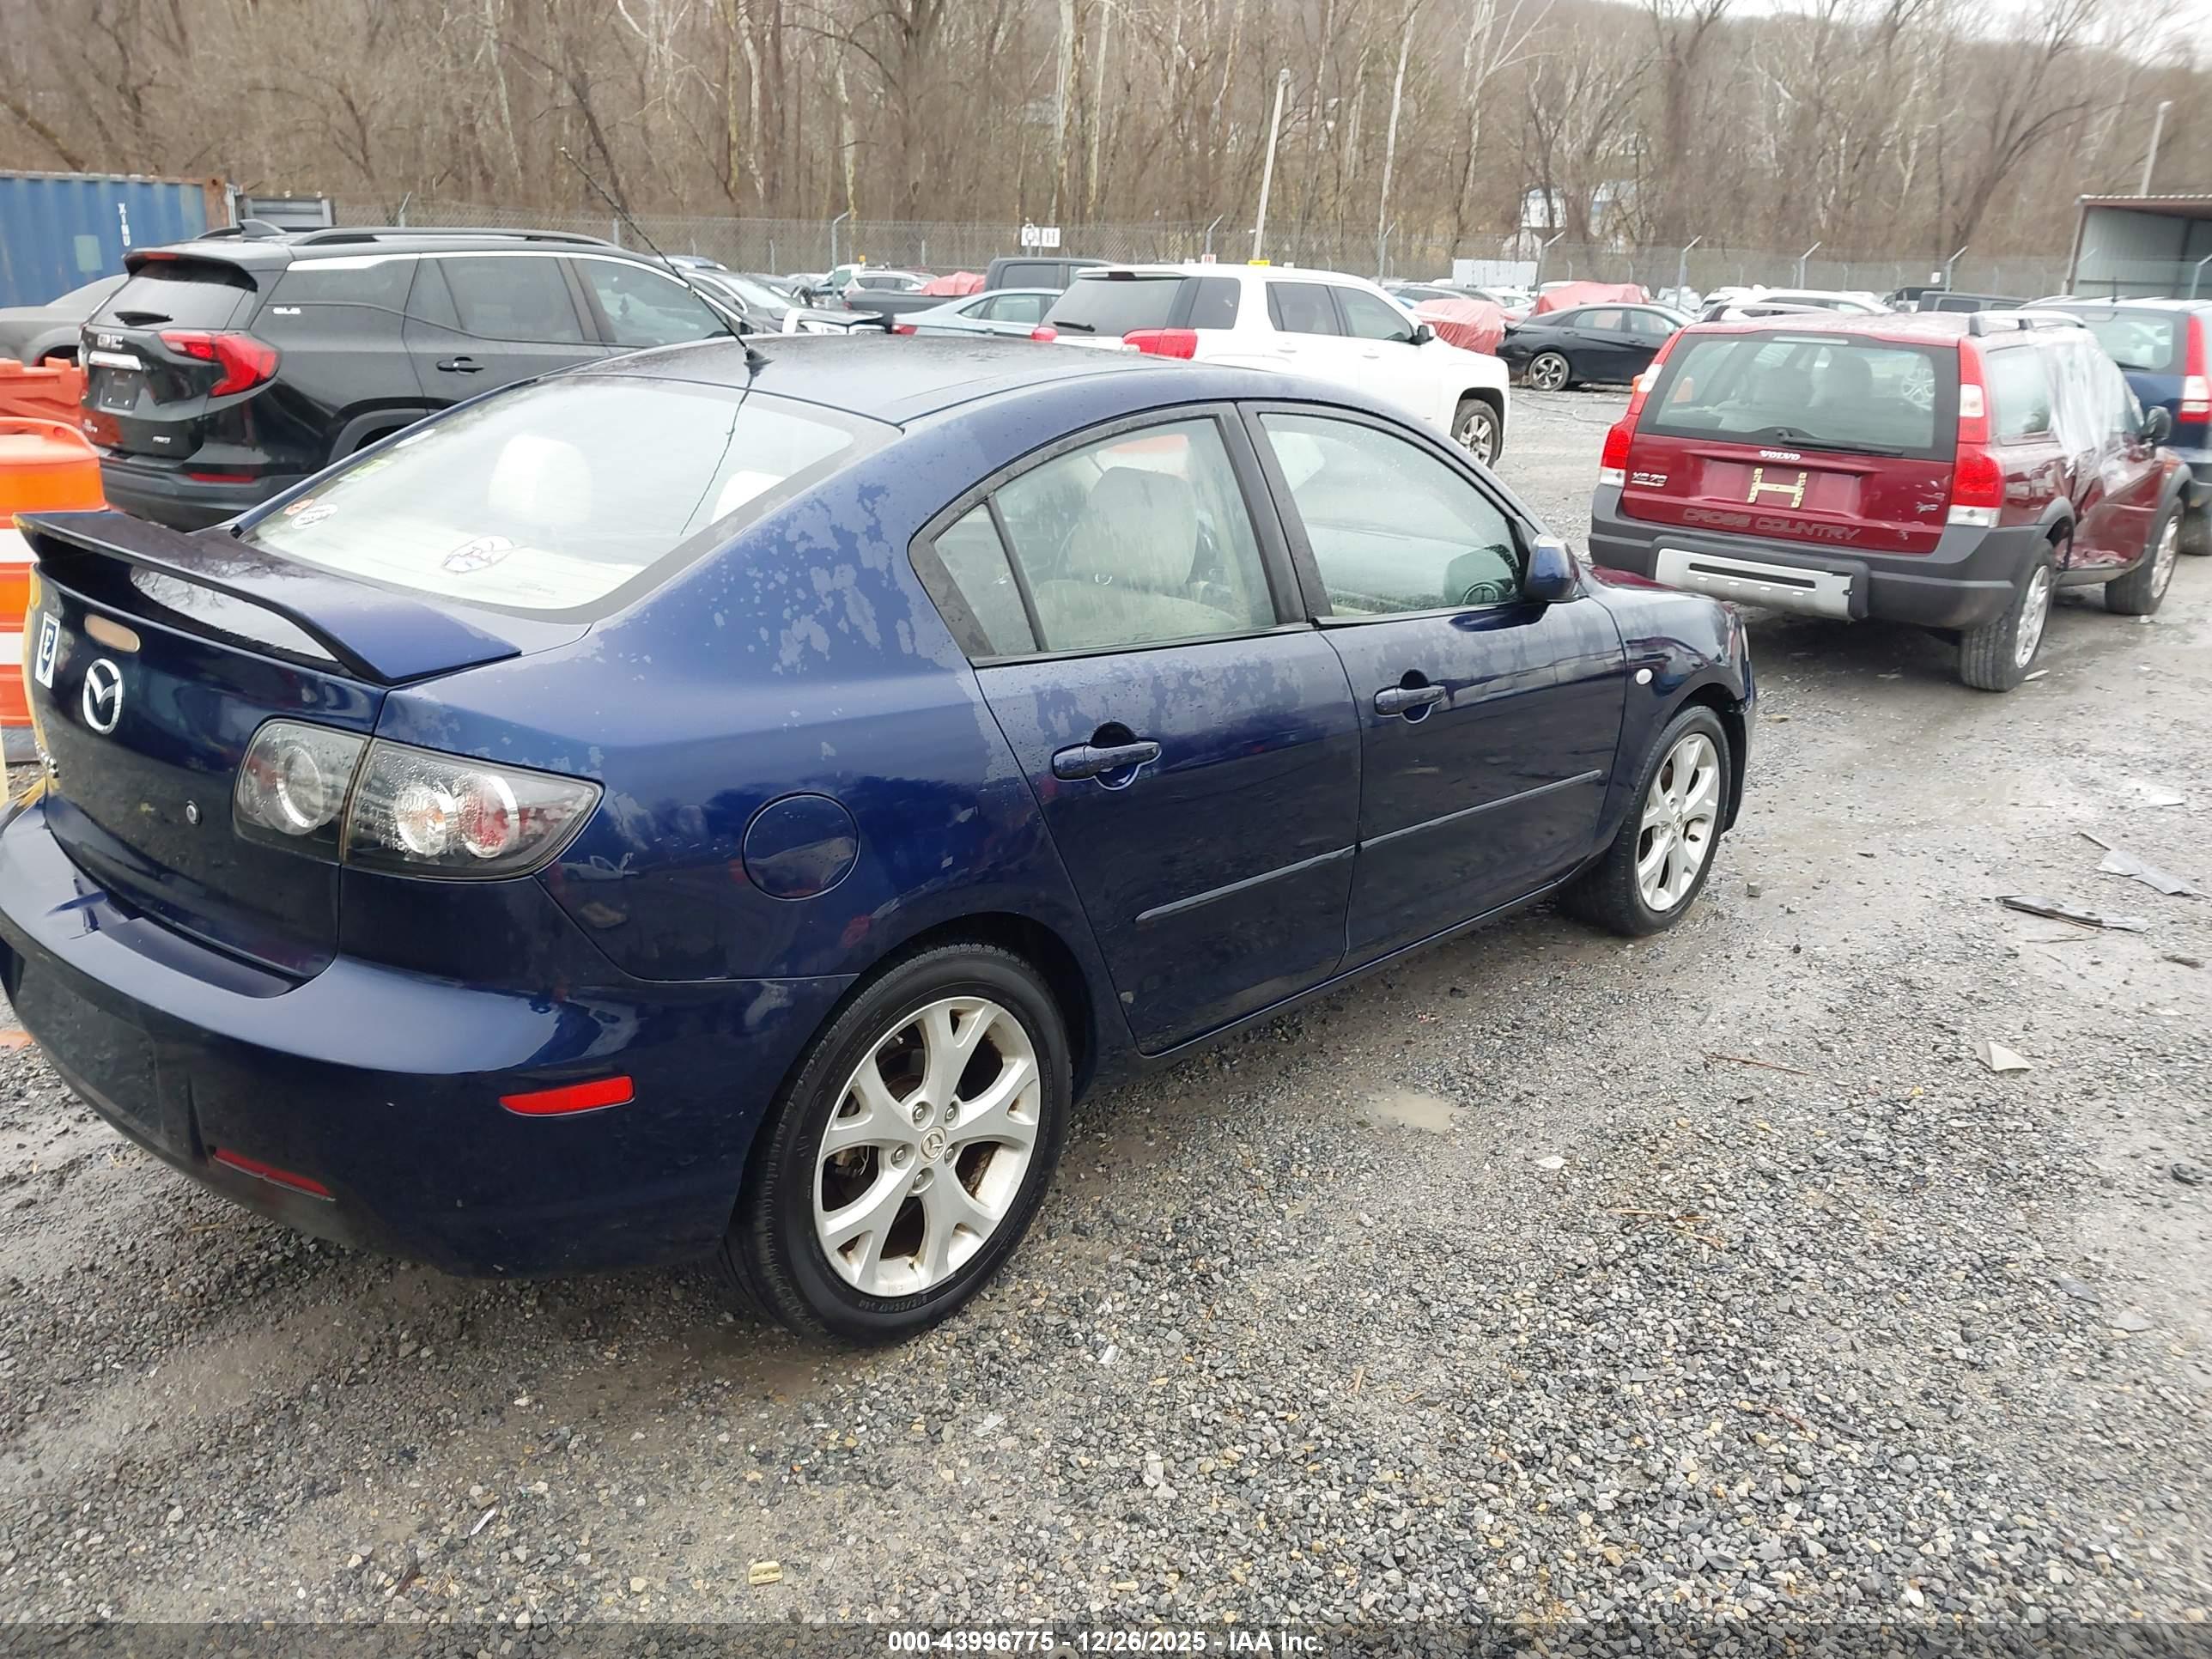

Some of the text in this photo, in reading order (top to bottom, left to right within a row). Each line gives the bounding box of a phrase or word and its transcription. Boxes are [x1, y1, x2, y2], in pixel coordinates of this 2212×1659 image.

[1759, 449, 1801, 461] VOLVO
[1682, 507, 1862, 541] CROSS COUNTRY
